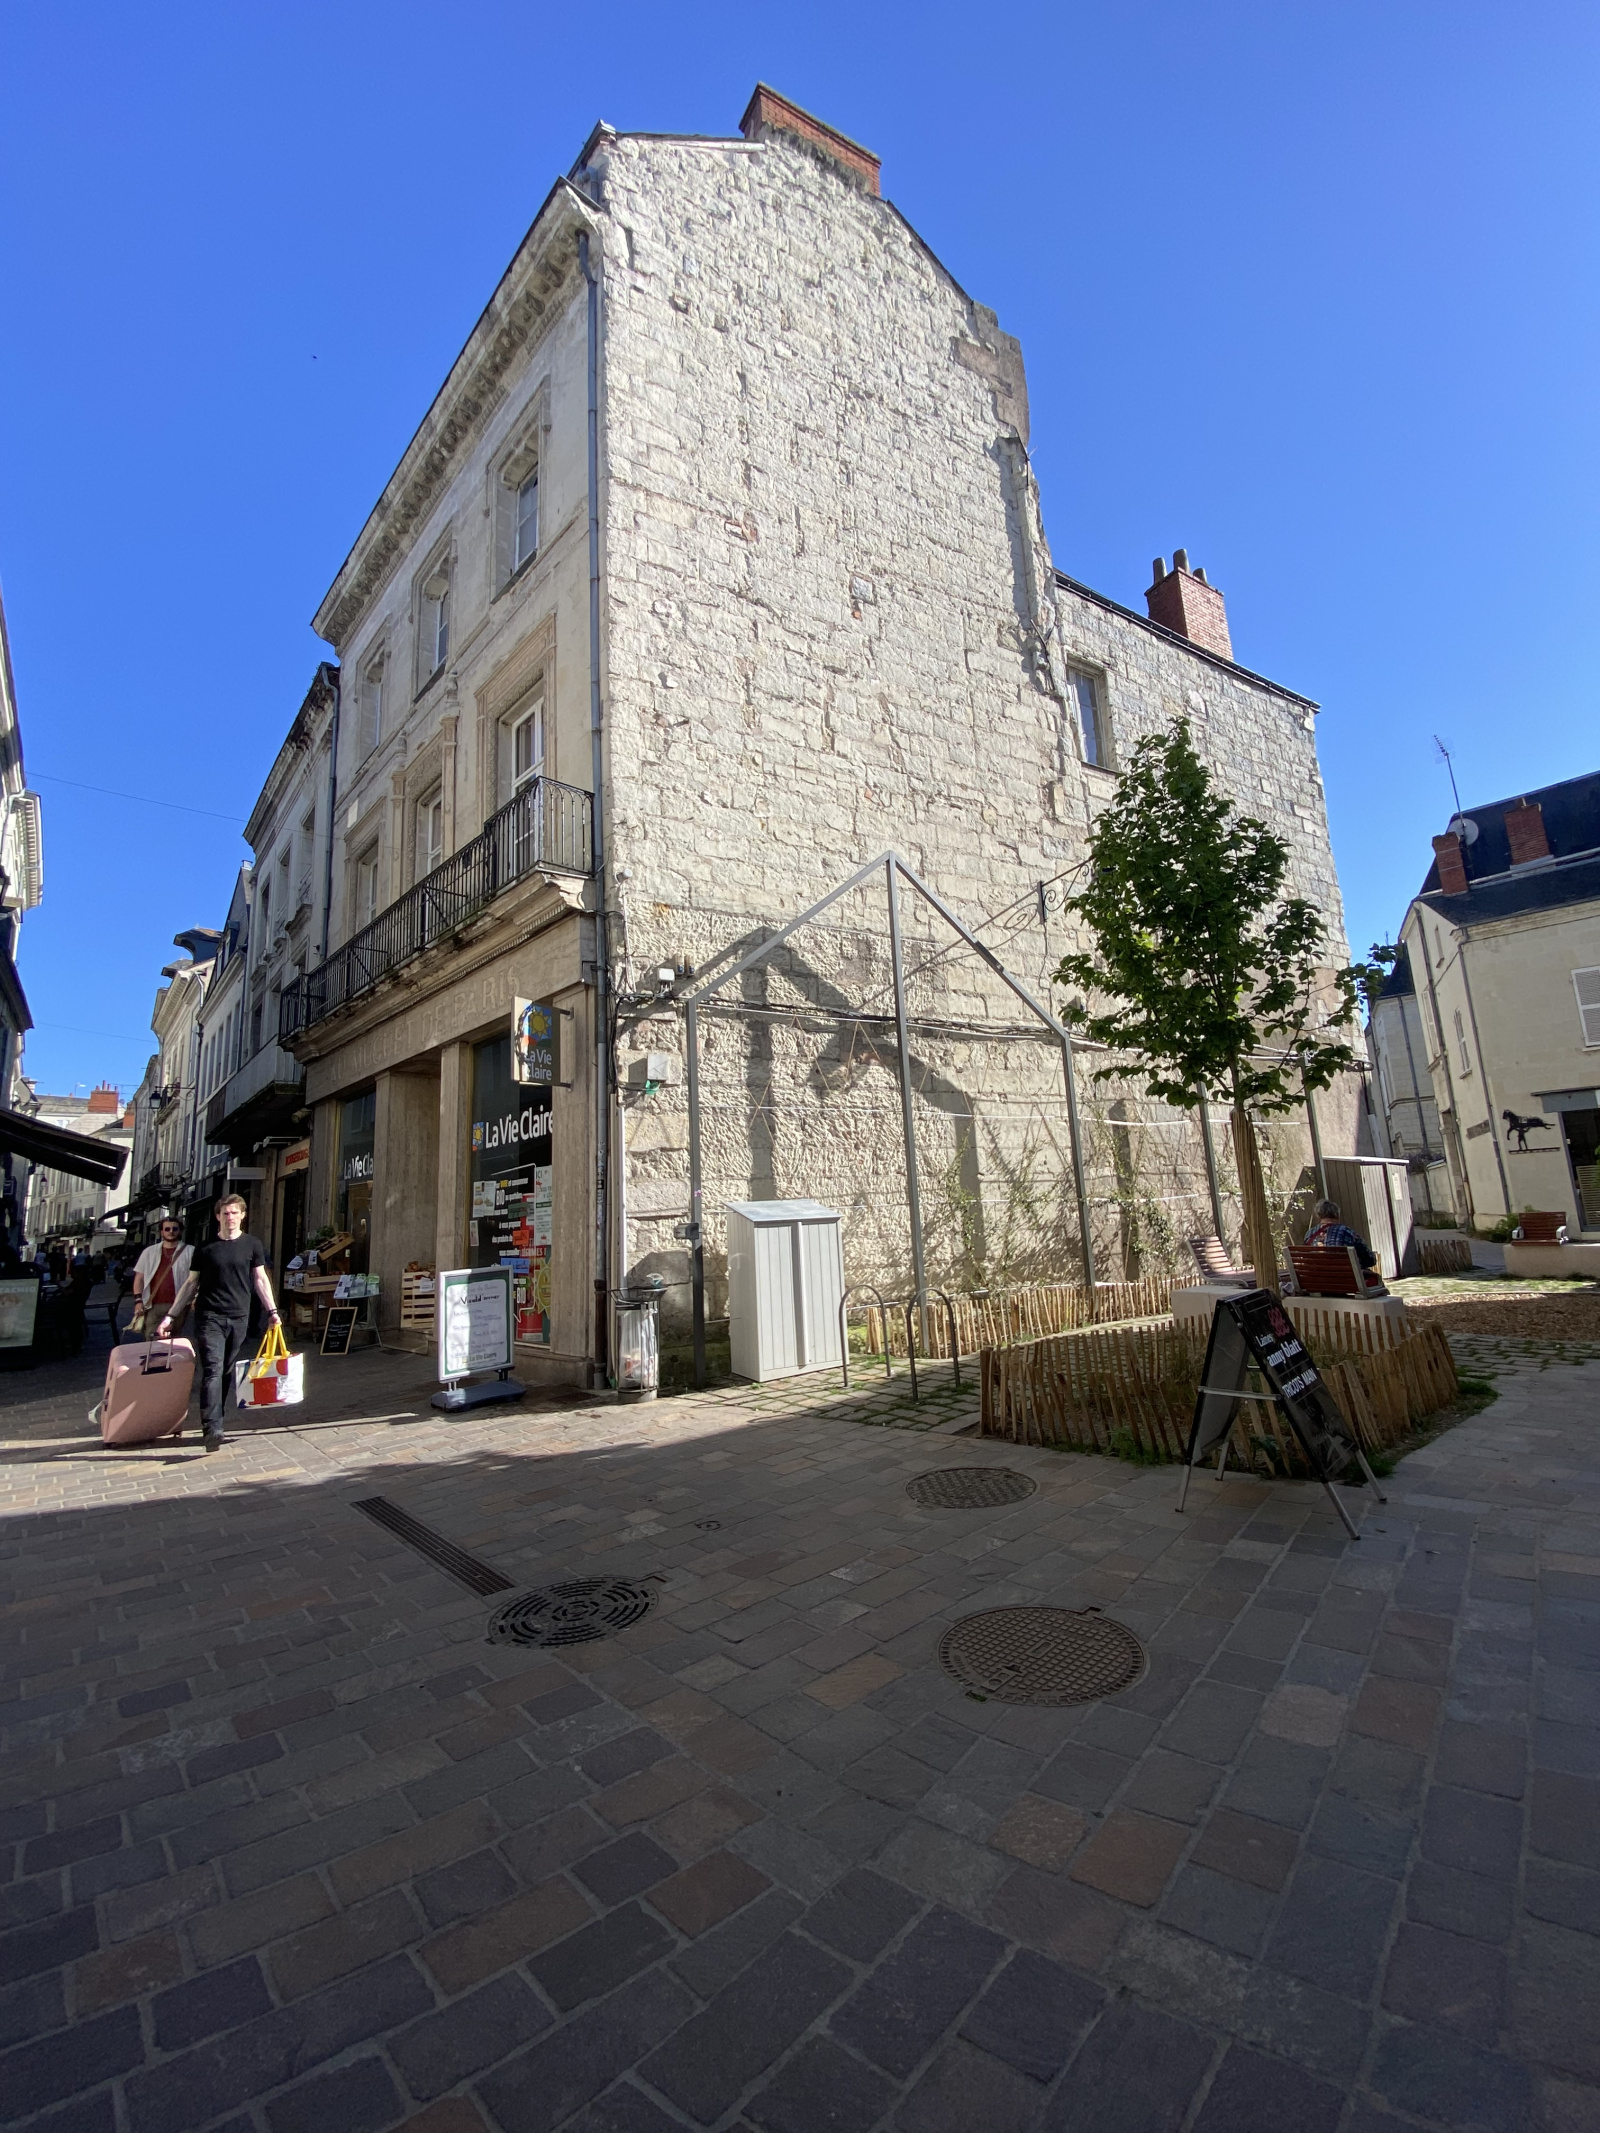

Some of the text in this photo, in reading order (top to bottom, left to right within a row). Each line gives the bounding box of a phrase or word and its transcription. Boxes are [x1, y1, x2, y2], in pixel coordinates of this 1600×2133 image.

[331, 965, 521, 1081] AU MUGUET DE PARIS
[524, 1049, 552, 1065] La Vie
[485, 1121, 499, 1149] La
[499, 1113, 519, 1145] Vie
[344, 1160, 352, 1179] La
[351, 1155, 363, 1177] Vie
[496, 1189, 506, 1206] BIO
[516, 1286, 527, 1304] BIO
[1266, 1337, 1303, 1367] anny blatt
[1282, 1367, 1318, 1399] TRICOTS MAIN
